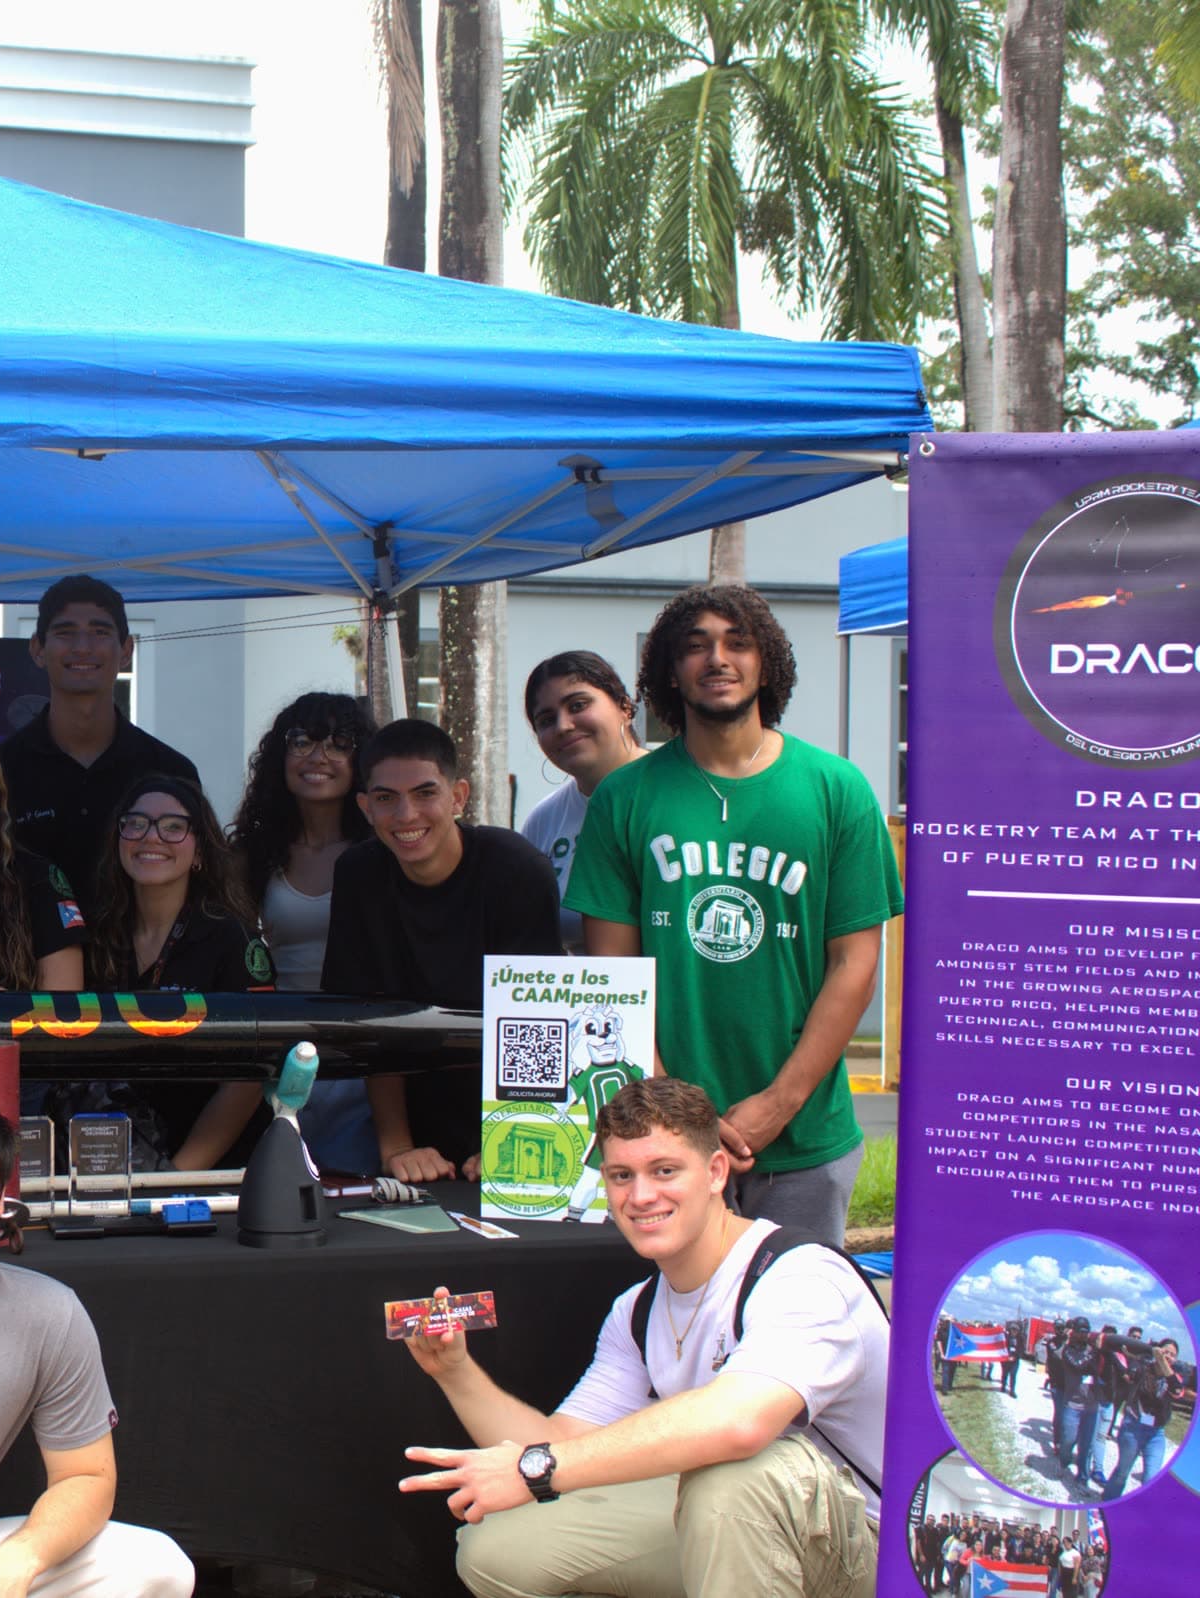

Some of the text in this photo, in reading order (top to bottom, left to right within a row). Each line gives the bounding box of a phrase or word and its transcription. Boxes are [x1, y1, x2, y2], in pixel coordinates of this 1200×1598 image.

[1074, 488, 1111, 509] UPRM
[1112, 481, 1179, 495] ROCKETRY
[1065, 734, 1088, 751] DEL
[1089, 744, 1142, 761] COLEGIO
[913, 823, 1040, 838] ROCKETRY
[1051, 826, 1117, 840] TEAM
[1129, 828, 1160, 841] AT
[650, 834, 807, 895] COLEGIO
[943, 851, 974, 863] OF
[985, 852, 1083, 867] PUERTO
[1097, 855, 1158, 869] RICO
[652, 911, 672, 927] EST.
[1069, 925, 1115, 937] OUR
[962, 942, 1020, 953] DRACO
[1027, 944, 1068, 955] AIMS
[1075, 947, 1096, 956] TO
[1104, 948, 1184, 960] DEVELOP
[491, 964, 609, 987] ¡Únete a los
[935, 959, 1017, 972] AMONGST
[1024, 963, 1067, 974] STEM
[1075, 965, 1136, 977] FIELDS
[1143, 968, 1180, 979] AND
[960, 978, 976, 989] IN
[984, 979, 1016, 990] THE
[1023, 982, 1103, 994] GROWING
[511, 987, 648, 1008] CAAMpeones!
[938, 995, 1004, 1008] PUERTO
[1011, 999, 1058, 1012] RICO,
[1065, 1002, 1141, 1015] HELPING
[944, 1014, 1045, 1030] TECHNICAL,
[935, 1032, 1195, 1056] SKILLS NECESSARY TO EXCEL
[1066, 1077, 1200, 1097] OUR VISION
[957, 1092, 1015, 1105] DRACO
[1022, 1097, 1063, 1108] AIMS
[1071, 1100, 1091, 1110] TO
[1099, 1102, 1171, 1116] BECOME
[962, 1111, 1081, 1129] COMPETITORS
[1089, 1120, 1106, 1130] IN
[1114, 1122, 1146, 1133] THE
[925, 1127, 1000, 1142] STUDENT
[1008, 1133, 1076, 1147] LAUNCH
[928, 1146, 988, 1159] IMPACT
[995, 1151, 1018, 1161] ON
[1026, 1154, 1037, 1163] A
[1043, 1154, 1155, 1172] SIGNIFICANT
[936, 1165, 1060, 1183] ENCOURAGING
[1067, 1175, 1114, 1188] THEM
[1121, 1180, 1142, 1190] TO
[1011, 1190, 1043, 1201] THE
[1050, 1193, 1155, 1210] AEROSPACE
